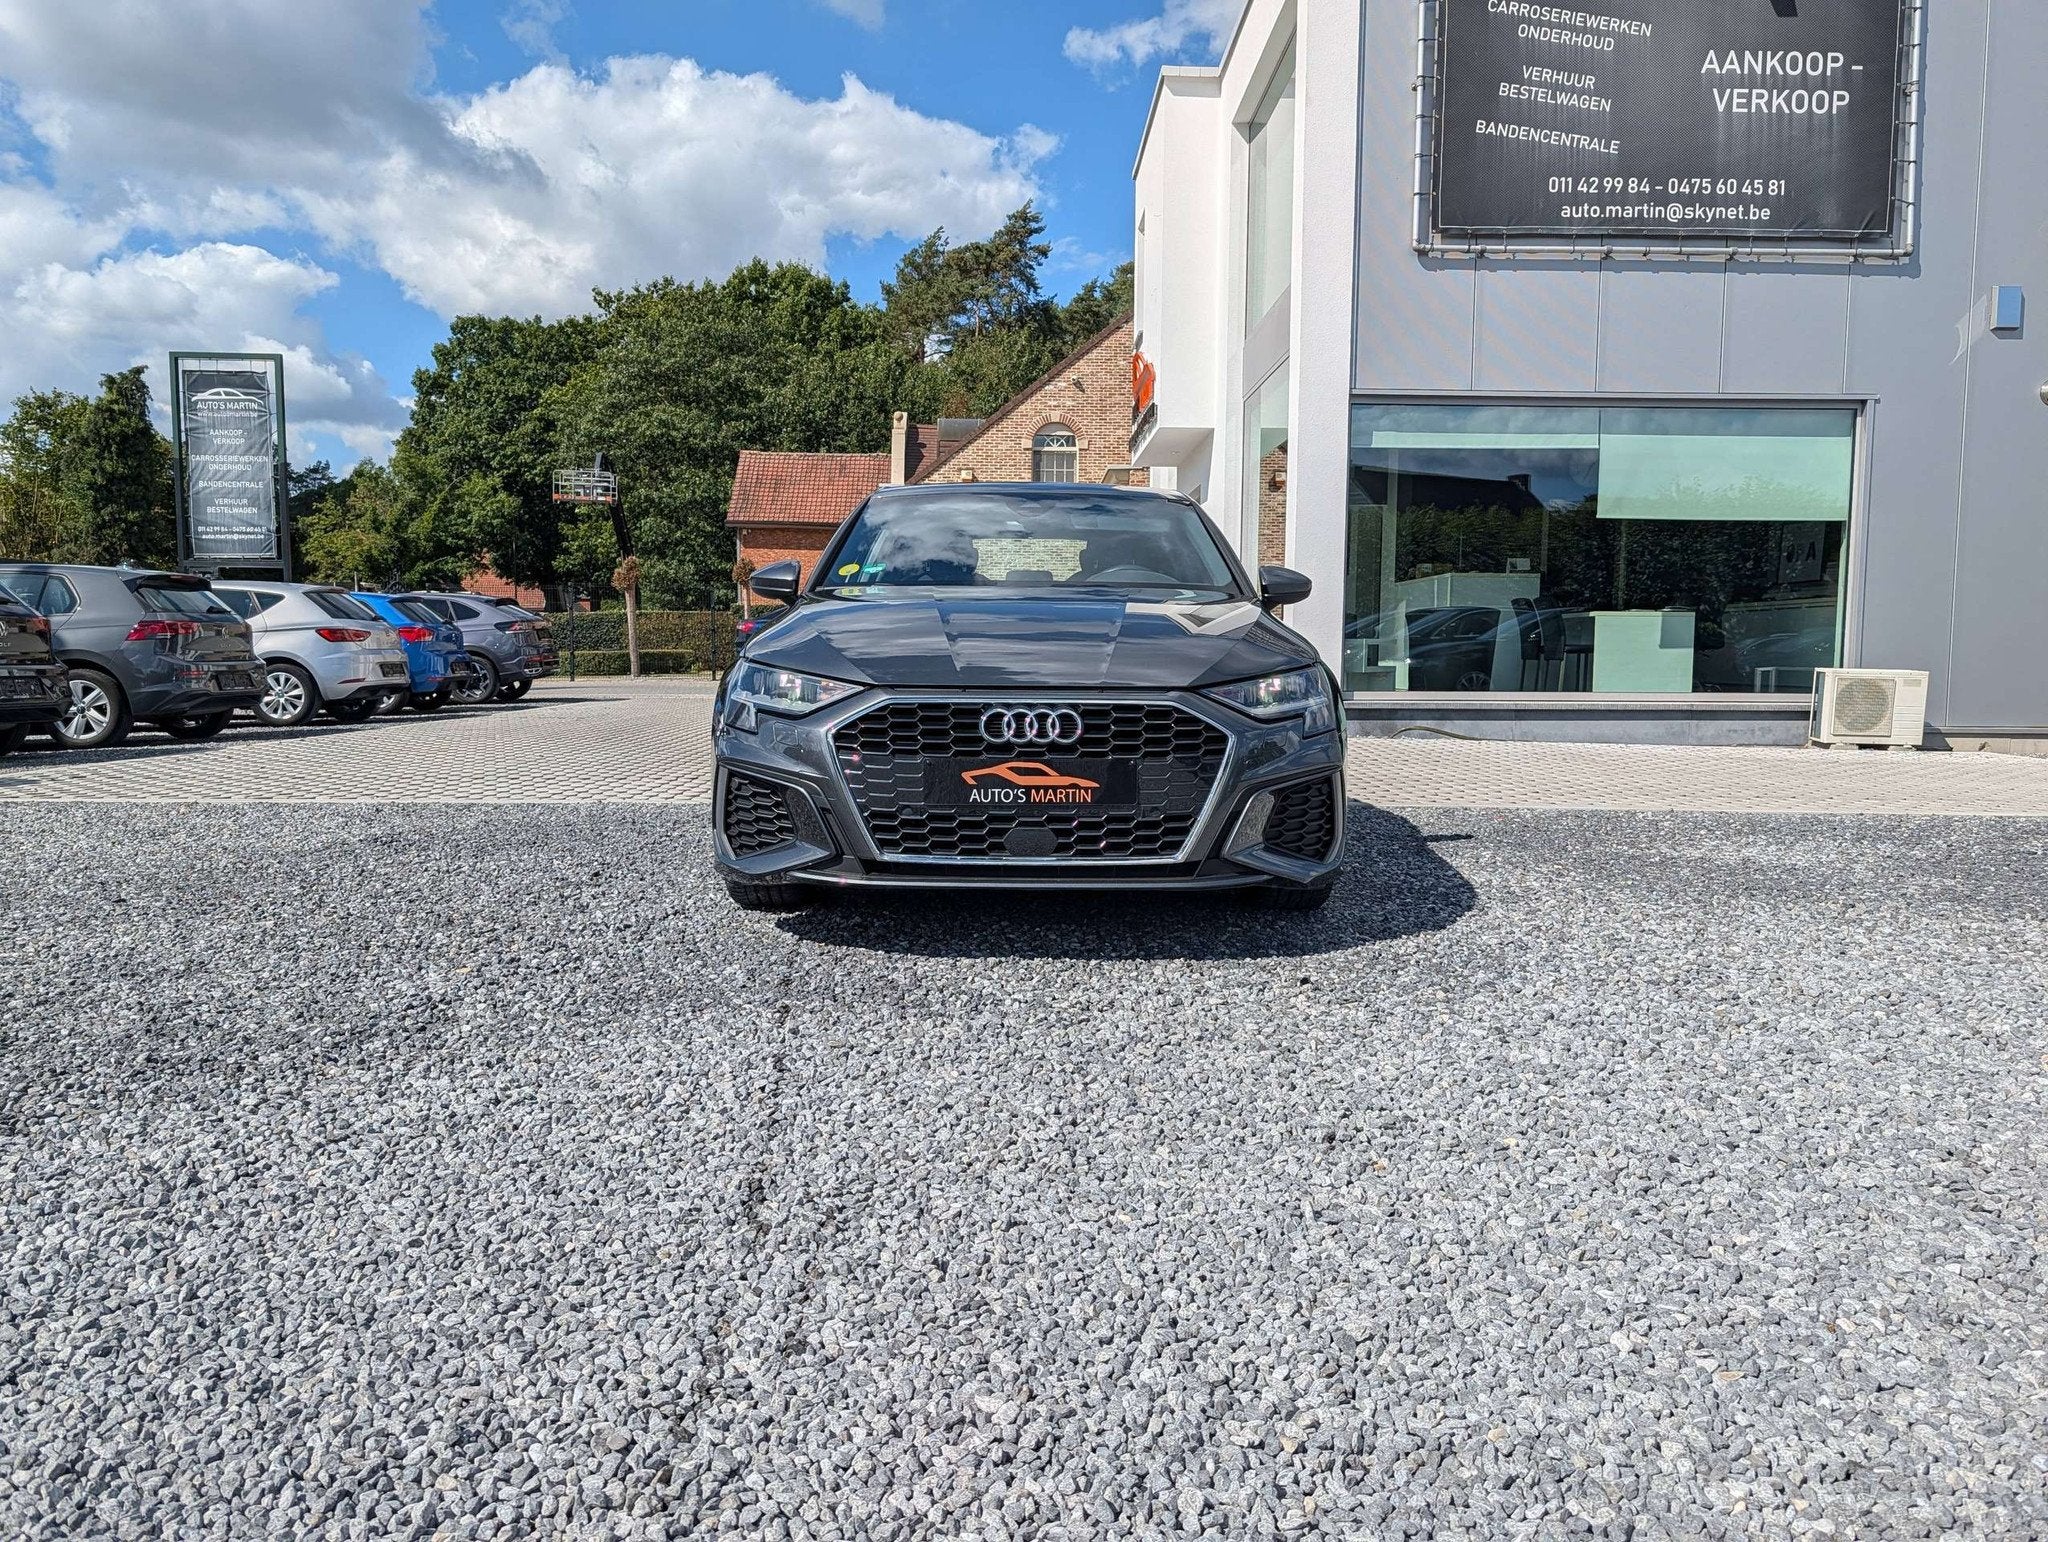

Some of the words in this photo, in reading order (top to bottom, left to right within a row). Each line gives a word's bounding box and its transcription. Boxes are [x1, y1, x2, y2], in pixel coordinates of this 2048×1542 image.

[1487, 0, 1652, 37] CARROSERIEWERKEN
[1518, 24, 1615, 51] ONDERHOUD
[1700, 50, 1844, 76] AANKOOP
[1522, 65, 1596, 89] VERHUUR
[1499, 82, 1612, 112] BESTELWAGEN
[1712, 88, 1850, 114] VERKOOP
[1475, 119, 1621, 154] BANDENCENTRALE
[1549, 177, 1573, 193] 011
[1577, 177, 1599, 193] 42
[1603, 177, 1624, 194] 99
[1627, 178, 1650, 194] 84
[1668, 178, 1712, 195] 0475
[1716, 178, 1737, 195] 60
[1742, 179, 1763, 195] 45
[1768, 179, 1786, 196] 81
[1561, 203, 1771, 223] auto.martin@skynet.be
[196, 401, 226, 410] AUTO'S
[226, 401, 258, 410] MARTIN
[209, 428, 243, 436] AANKOOP
[208, 463, 252, 471] ONDERHOUD
[198, 480, 264, 488] BANDENCENTRALE
[206, 506, 258, 514] BESTELWAGEN
[969, 788, 1026, 803] AUTO'S
[1031, 788, 1092, 803] MARTIN
